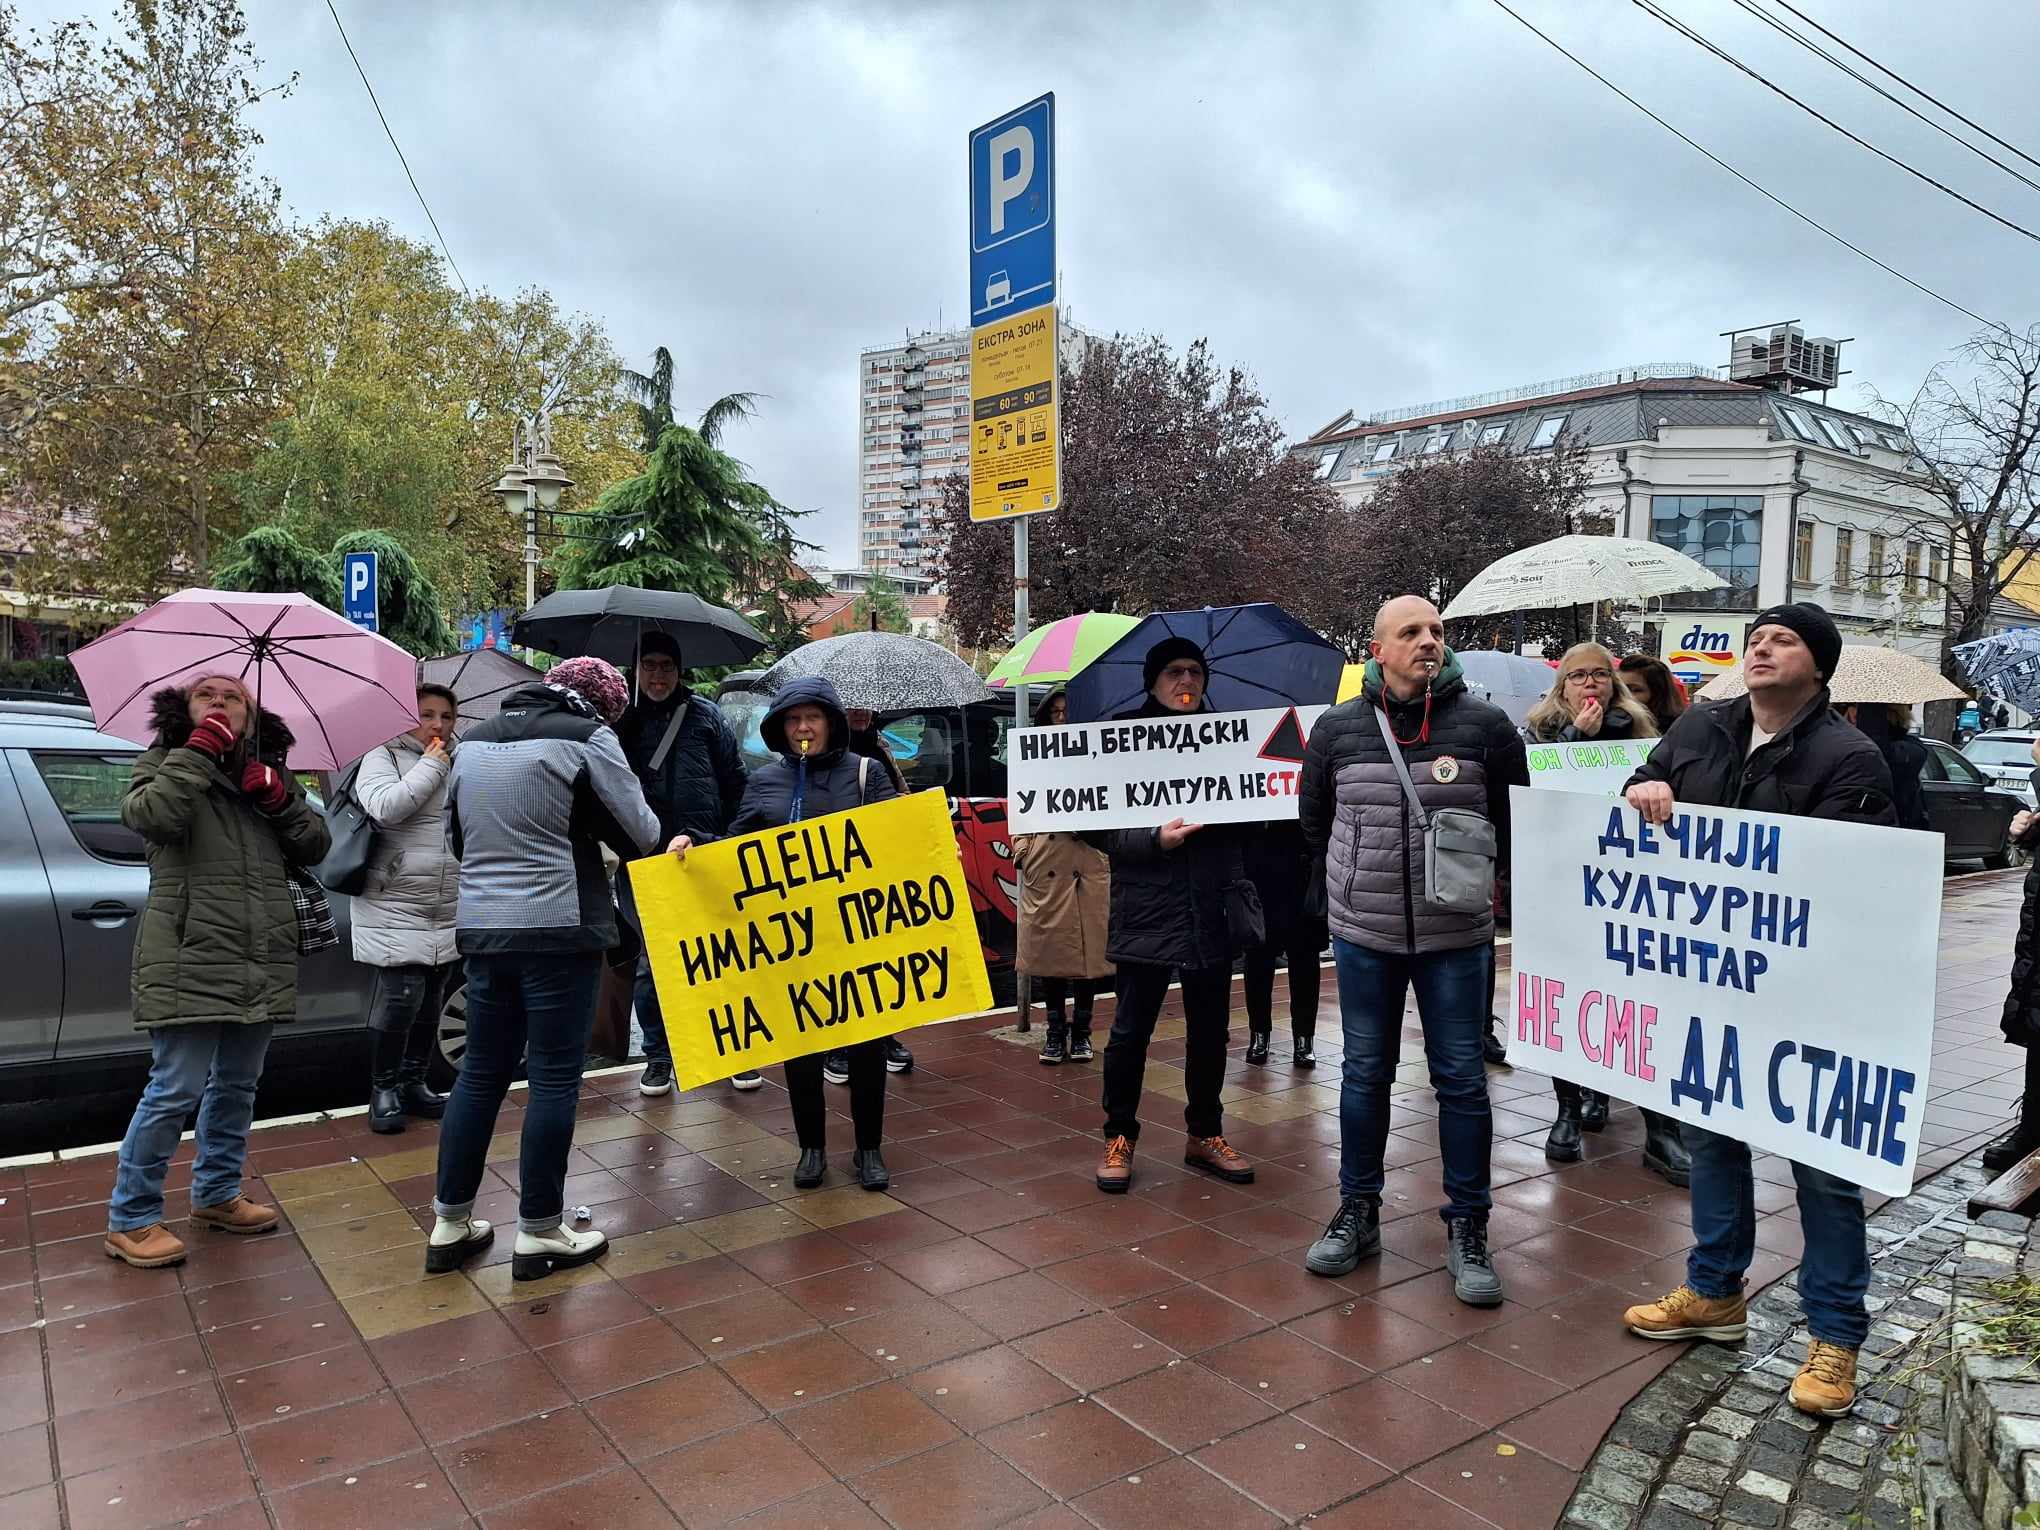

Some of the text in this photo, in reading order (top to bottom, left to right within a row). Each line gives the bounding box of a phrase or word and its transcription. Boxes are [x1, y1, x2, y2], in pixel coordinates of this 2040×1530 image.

[990, 125, 1034, 235] P
[978, 329, 1015, 350] ЕКСТРА
[1017, 318, 1046, 338] ЗОНА
[1000, 397, 1010, 410] 60
[1023, 391, 1035, 404] 90
[352, 561, 368, 602] P
[1680, 624, 1730, 651] dm
[1101, 718, 1250, 754] БЕРМУДСКИ
[1016, 789, 1037, 815] У
[1046, 785, 1109, 814] КОМЕ
[1125, 776, 1234, 808] КУЛТУРА
[733, 818, 873, 912] ДЕЦА
[1597, 806, 1781, 875] ДЕЧИЈИ
[679, 874, 955, 987] ИМАЈУ ПРАВО
[1582, 864, 1811, 949] КУЛТУРНИ
[1604, 921, 1768, 994] ЦЕНТАР
[708, 946, 949, 1057] НА КУЛТУРУ
[1517, 971, 1917, 1168] НЕ СМЕ ДА СТАНЕ
